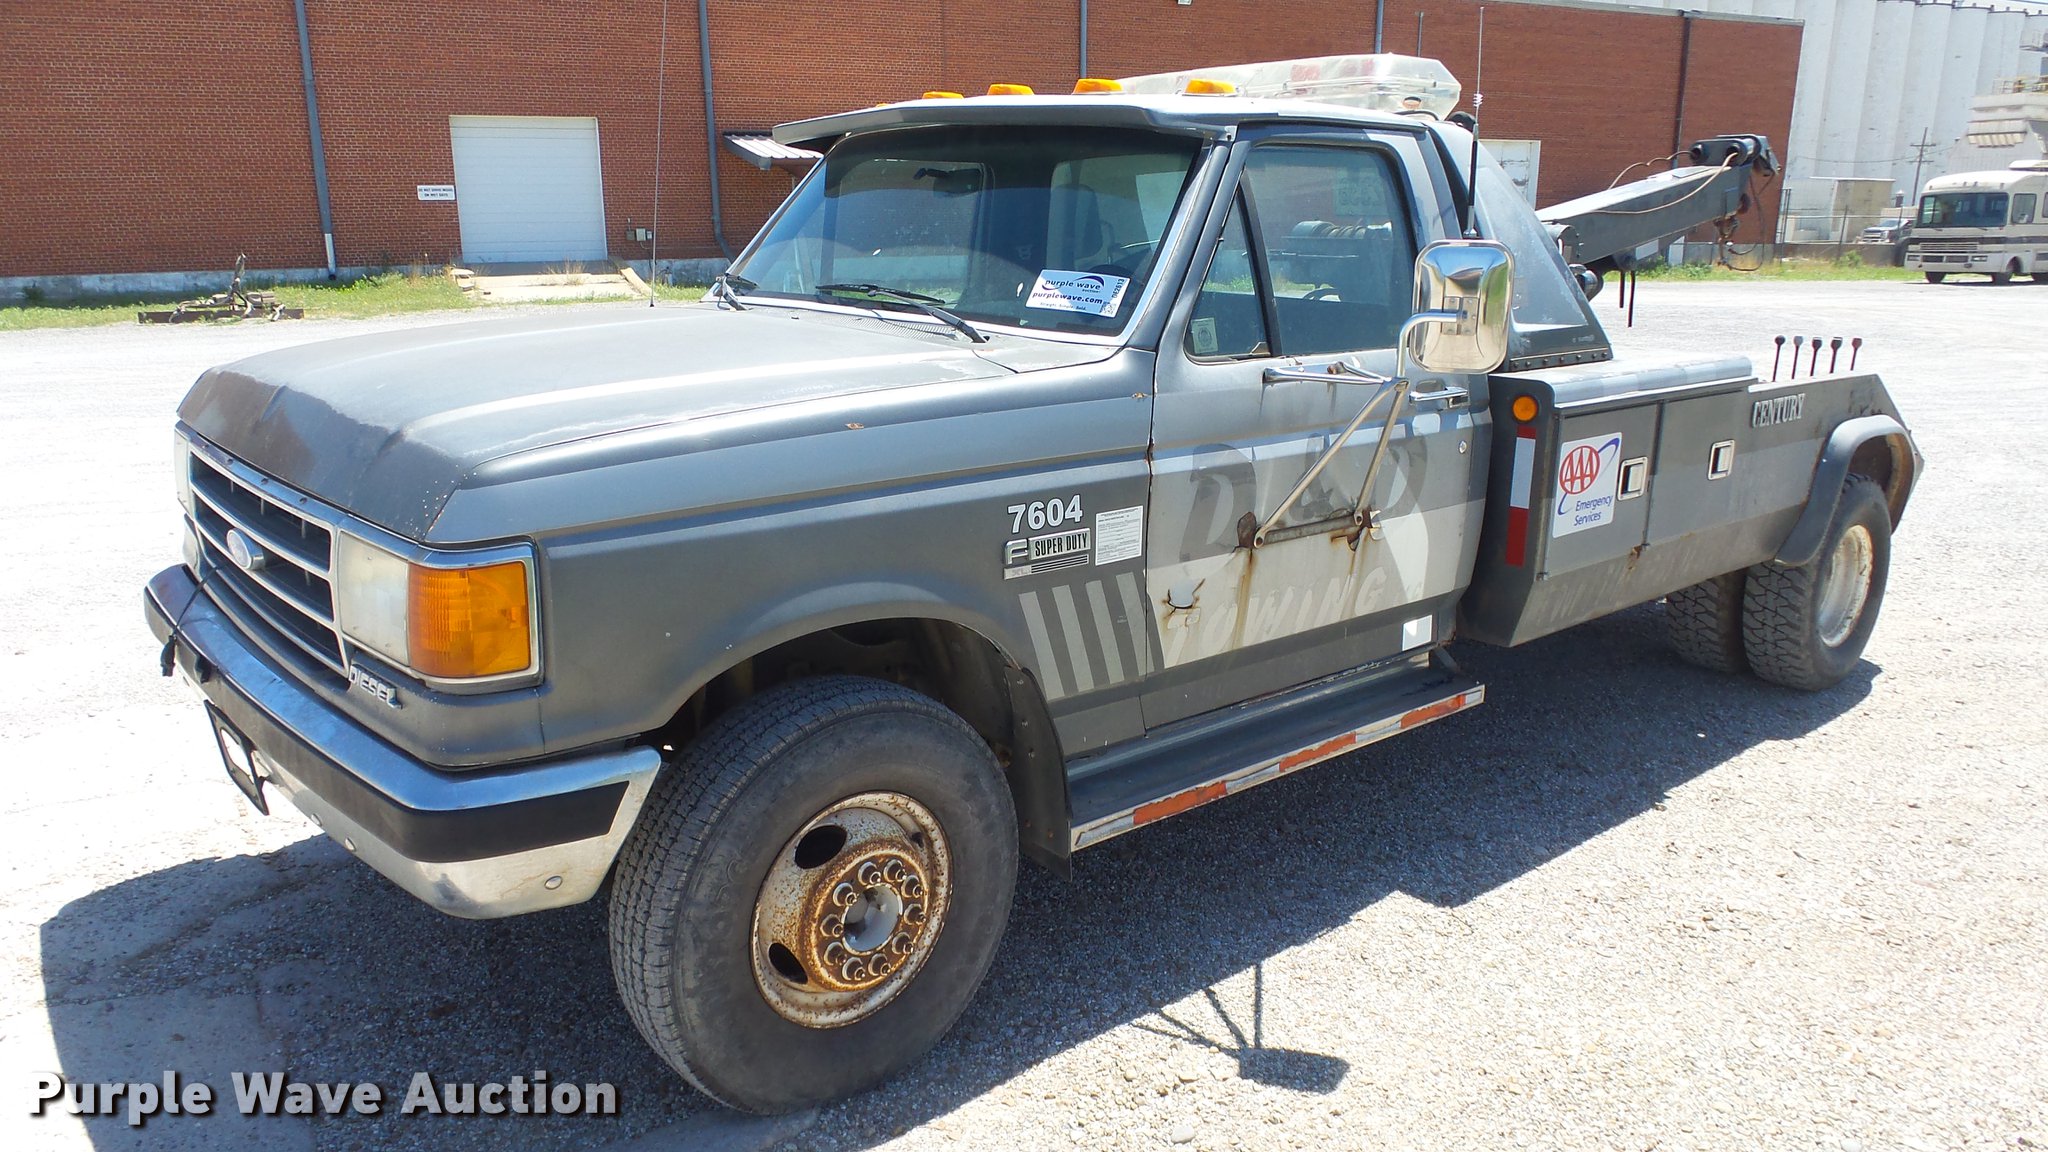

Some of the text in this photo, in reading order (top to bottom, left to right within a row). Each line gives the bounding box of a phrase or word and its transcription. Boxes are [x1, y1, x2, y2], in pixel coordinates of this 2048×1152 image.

[1032, 291, 1103, 304] purplewave.com
[1045, 279, 1101, 290] purple wave
[1751, 393, 1805, 427] CENTURY
[1560, 446, 1600, 494] AAA
[1007, 494, 1083, 534] 7604
[1574, 511, 1602, 526] Services
[1575, 495, 1613, 511] Emergency
[1004, 533, 1088, 565] F SUPER DUTY
[348, 664, 402, 709] DIESEL
